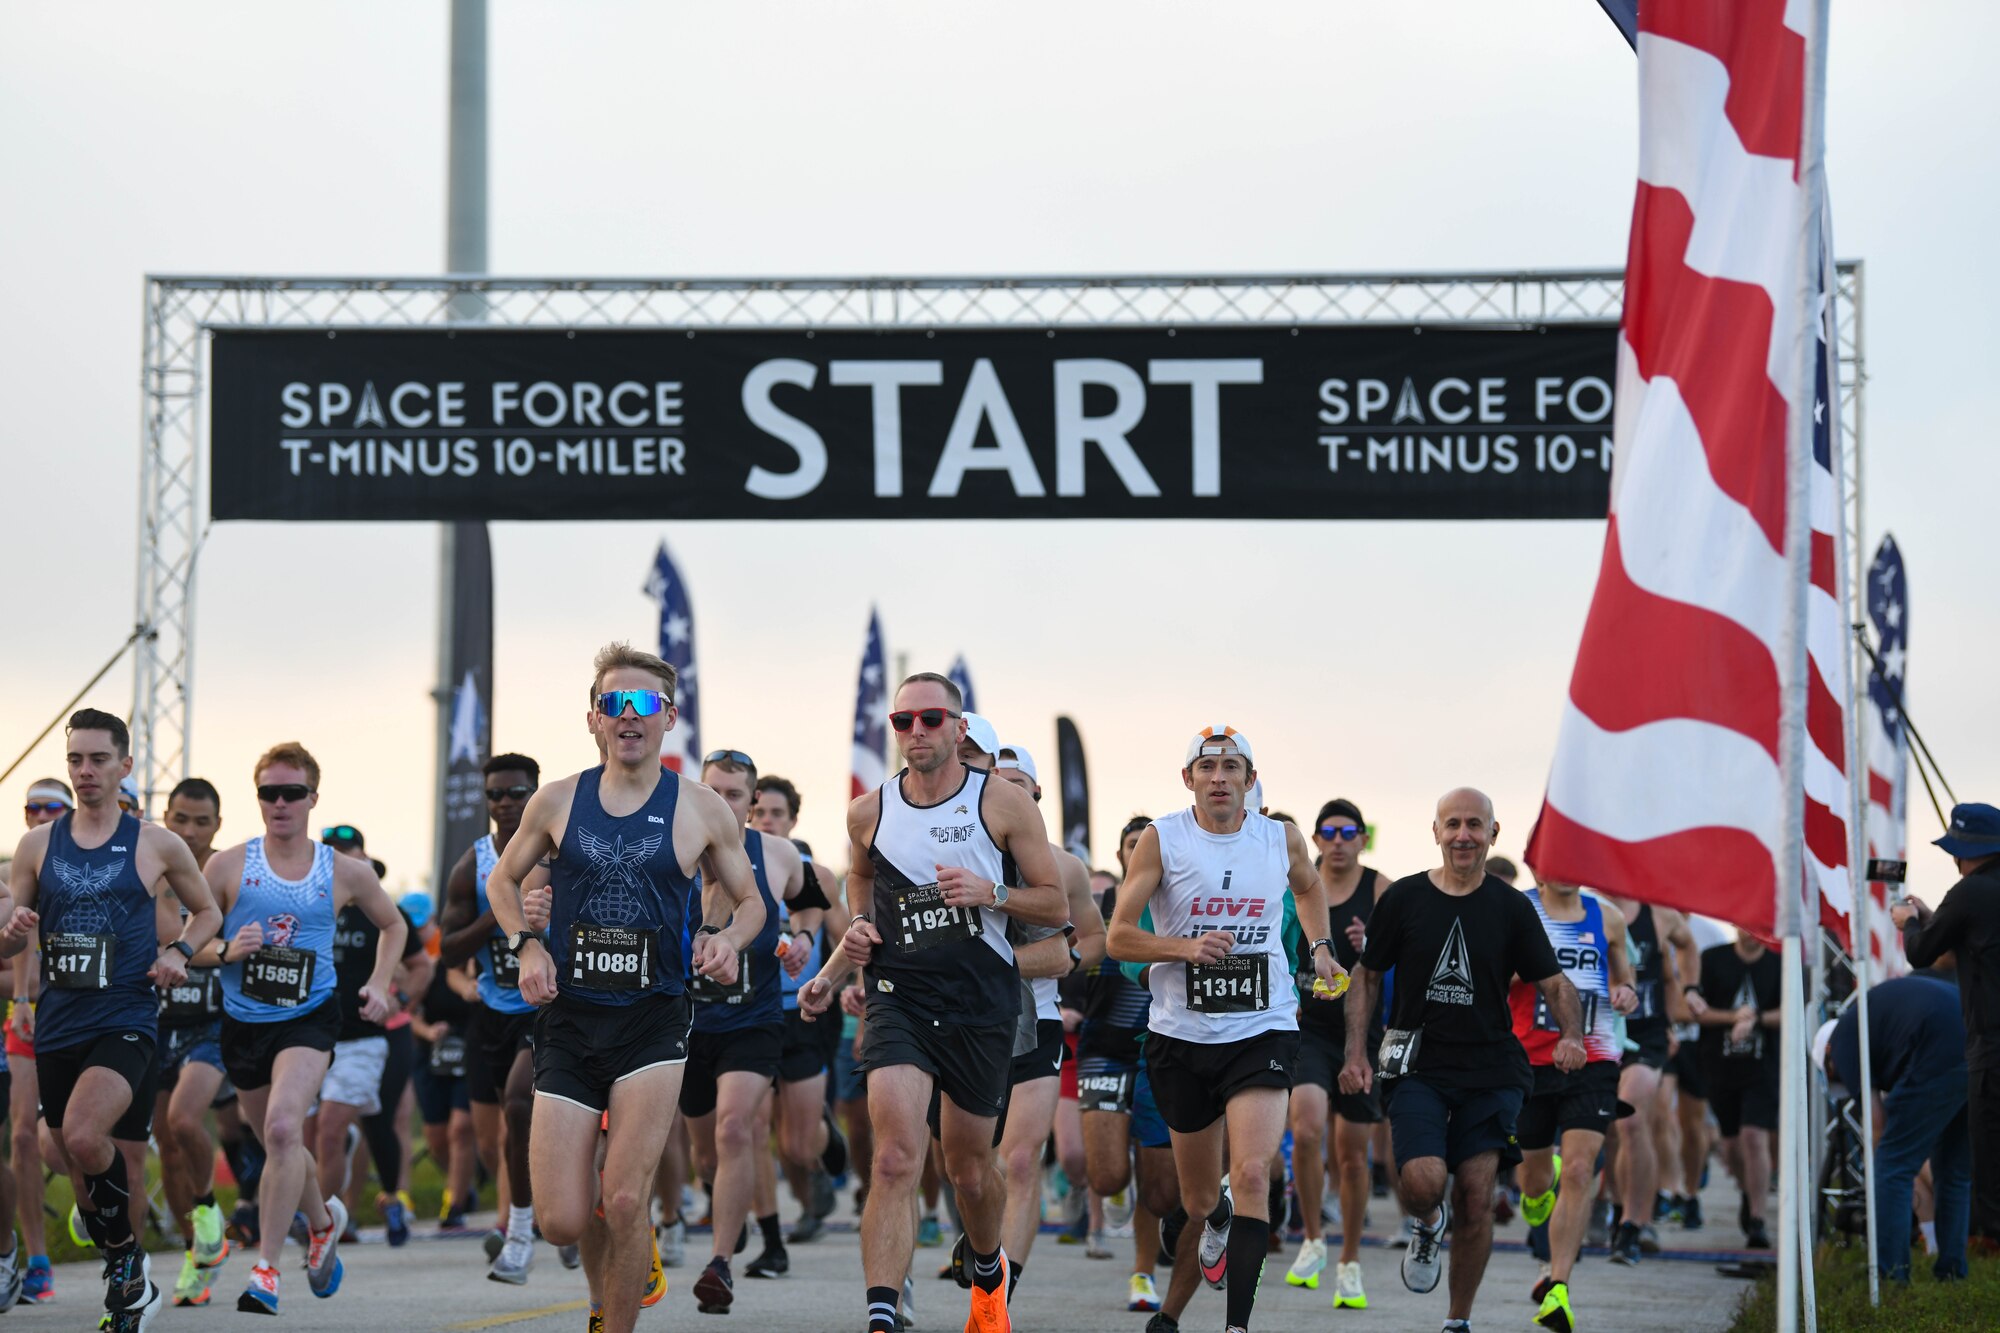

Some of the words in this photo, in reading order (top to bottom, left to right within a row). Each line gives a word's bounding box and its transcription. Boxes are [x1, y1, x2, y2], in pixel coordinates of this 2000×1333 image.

[282, 380, 465, 429] SPACE
[493, 381, 684, 427] FORCE
[1319, 377, 1506, 424] SPACE
[742, 358, 1264, 499] START
[281, 438, 478, 477] T-MINUS
[493, 438, 686, 476] 10-MILER
[1319, 435, 1518, 474] T-MINUS
[1222, 870, 1232, 890] i
[1190, 897, 1266, 917] LOVE
[911, 905, 960, 932] 1921
[588, 931, 611, 939] SPACE
[57, 954, 92, 973] 417
[585, 951, 639, 973] 1088
[1556, 947, 1600, 971] SA
[256, 963, 299, 985] 1585
[1202, 978, 1253, 997] 1314
[1433, 983, 1468, 993] INAUGURAL
[1450, 991, 1474, 1000] FORCE
[1083, 1075, 1119, 1092] 1025
